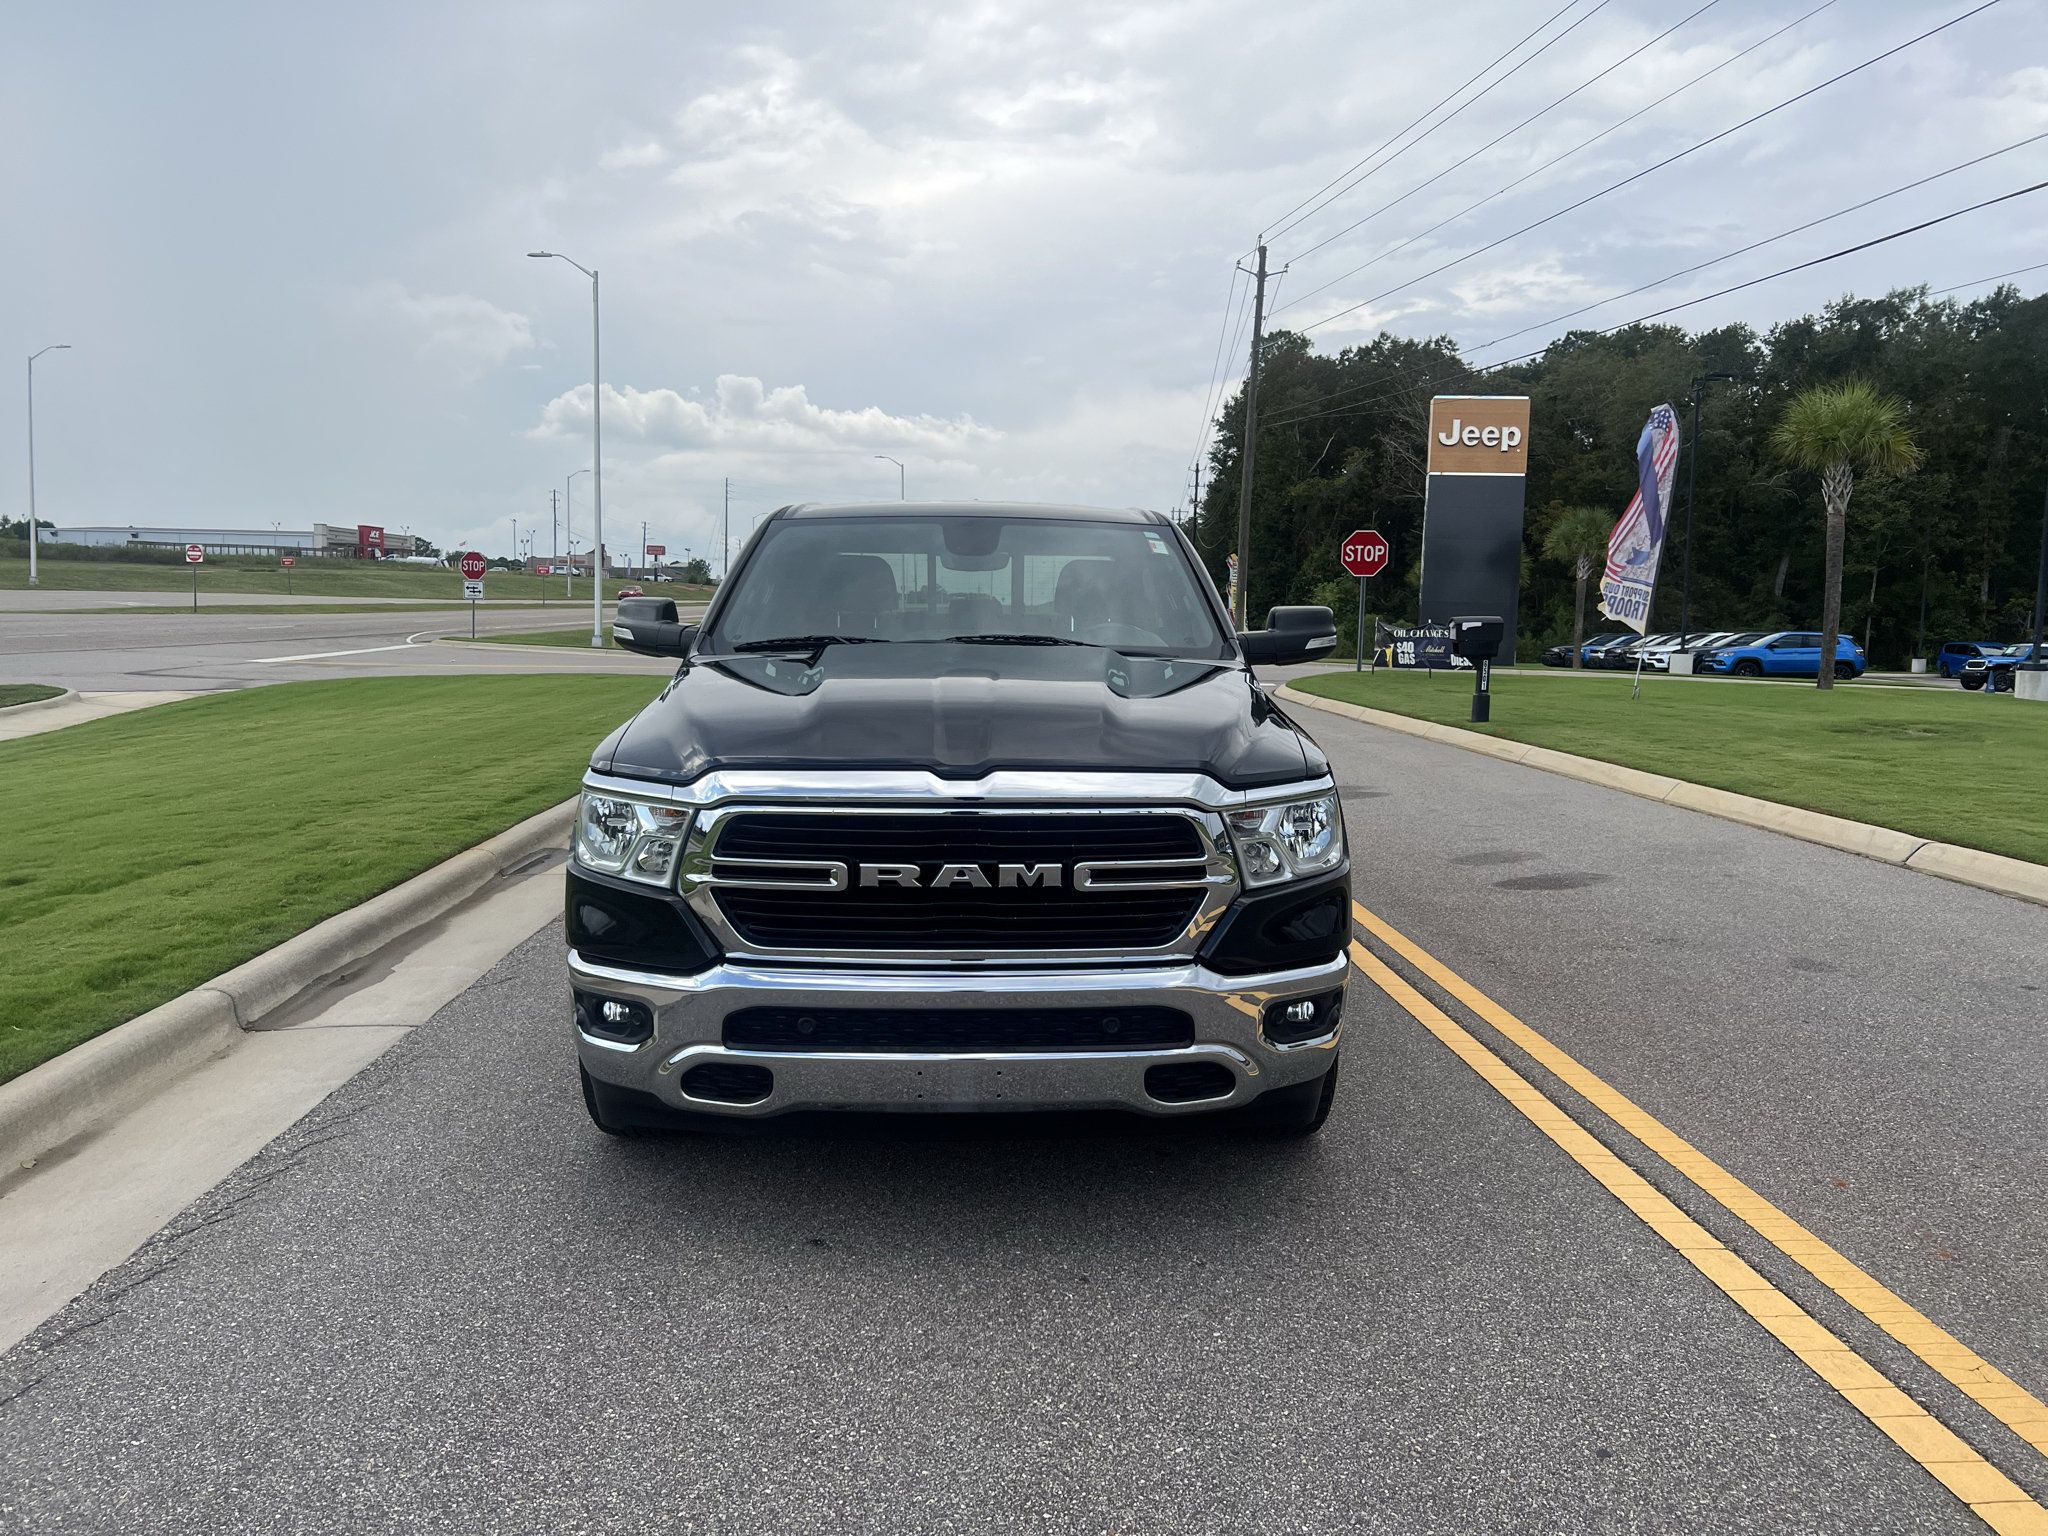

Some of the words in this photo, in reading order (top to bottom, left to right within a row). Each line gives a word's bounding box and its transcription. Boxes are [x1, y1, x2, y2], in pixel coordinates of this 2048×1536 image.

[1439, 419, 1521, 452] Jeep
[1345, 545, 1385, 562] STOP
[462, 560, 485, 571] STOP
[1393, 629, 1409, 638] OIL
[1410, 629, 1450, 638] CHANGES
[1398, 653, 1416, 665] GAS
[859, 863, 1063, 888] RAM
